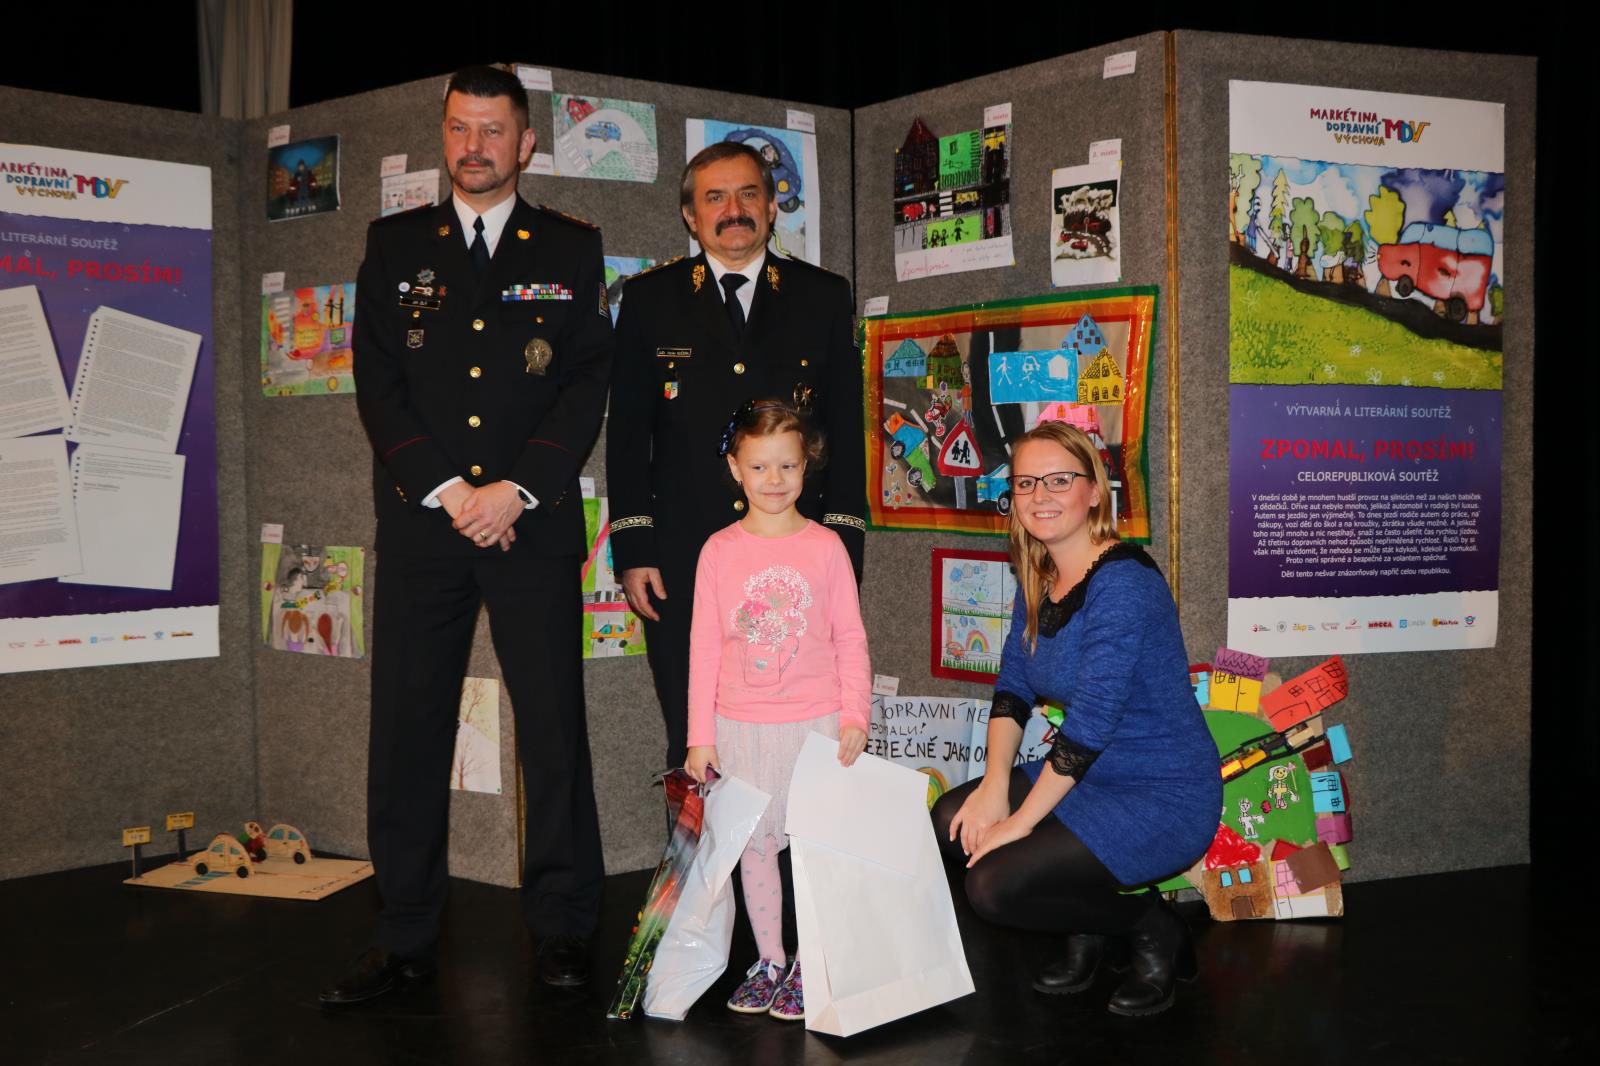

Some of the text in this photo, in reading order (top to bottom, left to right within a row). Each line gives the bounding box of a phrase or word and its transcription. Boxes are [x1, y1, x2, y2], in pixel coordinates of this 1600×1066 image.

[1310, 107, 1378, 123] MARKÉTINA
[1326, 121, 1382, 135] DOPRAVNÍ
[1381, 118, 1431, 143] MDV
[1334, 133, 1385, 146] VÝCHOVA
[0, 161, 69, 178] ARKÉTINA
[6, 174, 73, 189] DOPRAVNÍ
[73, 174, 129, 199] MDV
[16, 185, 77, 200] VÝCHOVA
[1, 231, 118, 250] LITERÁRNÍ SOUTĚŽ
[66, 258, 182, 286] PROSÍM!
[1286, 403, 1451, 419] VÝTVARNÁ A LITERÁRNÍ SOUTĚŽ
[1261, 433, 1473, 463] ZPOMAL, PROSÍM!
[1297, 469, 1439, 481] CELOREPUBLIKOVÁ SOUTĚŽ
[1299, 494, 1306, 502] je
[1357, 493, 1379, 502] provoz
[1260, 502, 1289, 510] dědečků.
[1322, 503, 1344, 511] nebylo
[1370, 503, 1391, 511] jelikož
[1287, 512, 1308, 521] jezdilo
[1309, 512, 1320, 521] jen
[1383, 512, 1398, 520] jezdí
[1450, 511, 1470, 519] práce,
[1257, 521, 1284, 529] nákupy,
[1354, 520, 1380, 528] kroužky,
[1456, 519, 1476, 527] jelikož
[1270, 530, 1285, 539] mají
[1436, 529, 1458, 537] rychlou
[1291, 538, 1327, 547] dopravních
[1349, 537, 1373, 546] způsobí
[1375, 537, 1414, 546] nepřiměřená
[1415, 537, 1441, 545] rychlost.
[1460, 537, 1469, 545] by
[1286, 548, 1318, 556] uvědomit,
[1363, 545, 1380, 553] může
[1395, 546, 1419, 554] kdykoli,
[1353, 555, 1382, 564] bezpečné
[1380, 569, 1399, 577] napříč
[1418, 568, 1451, 576] republikou.
[866, 736, 938, 758] EZPEČNĚ
[943, 741, 970, 762] JAKO
